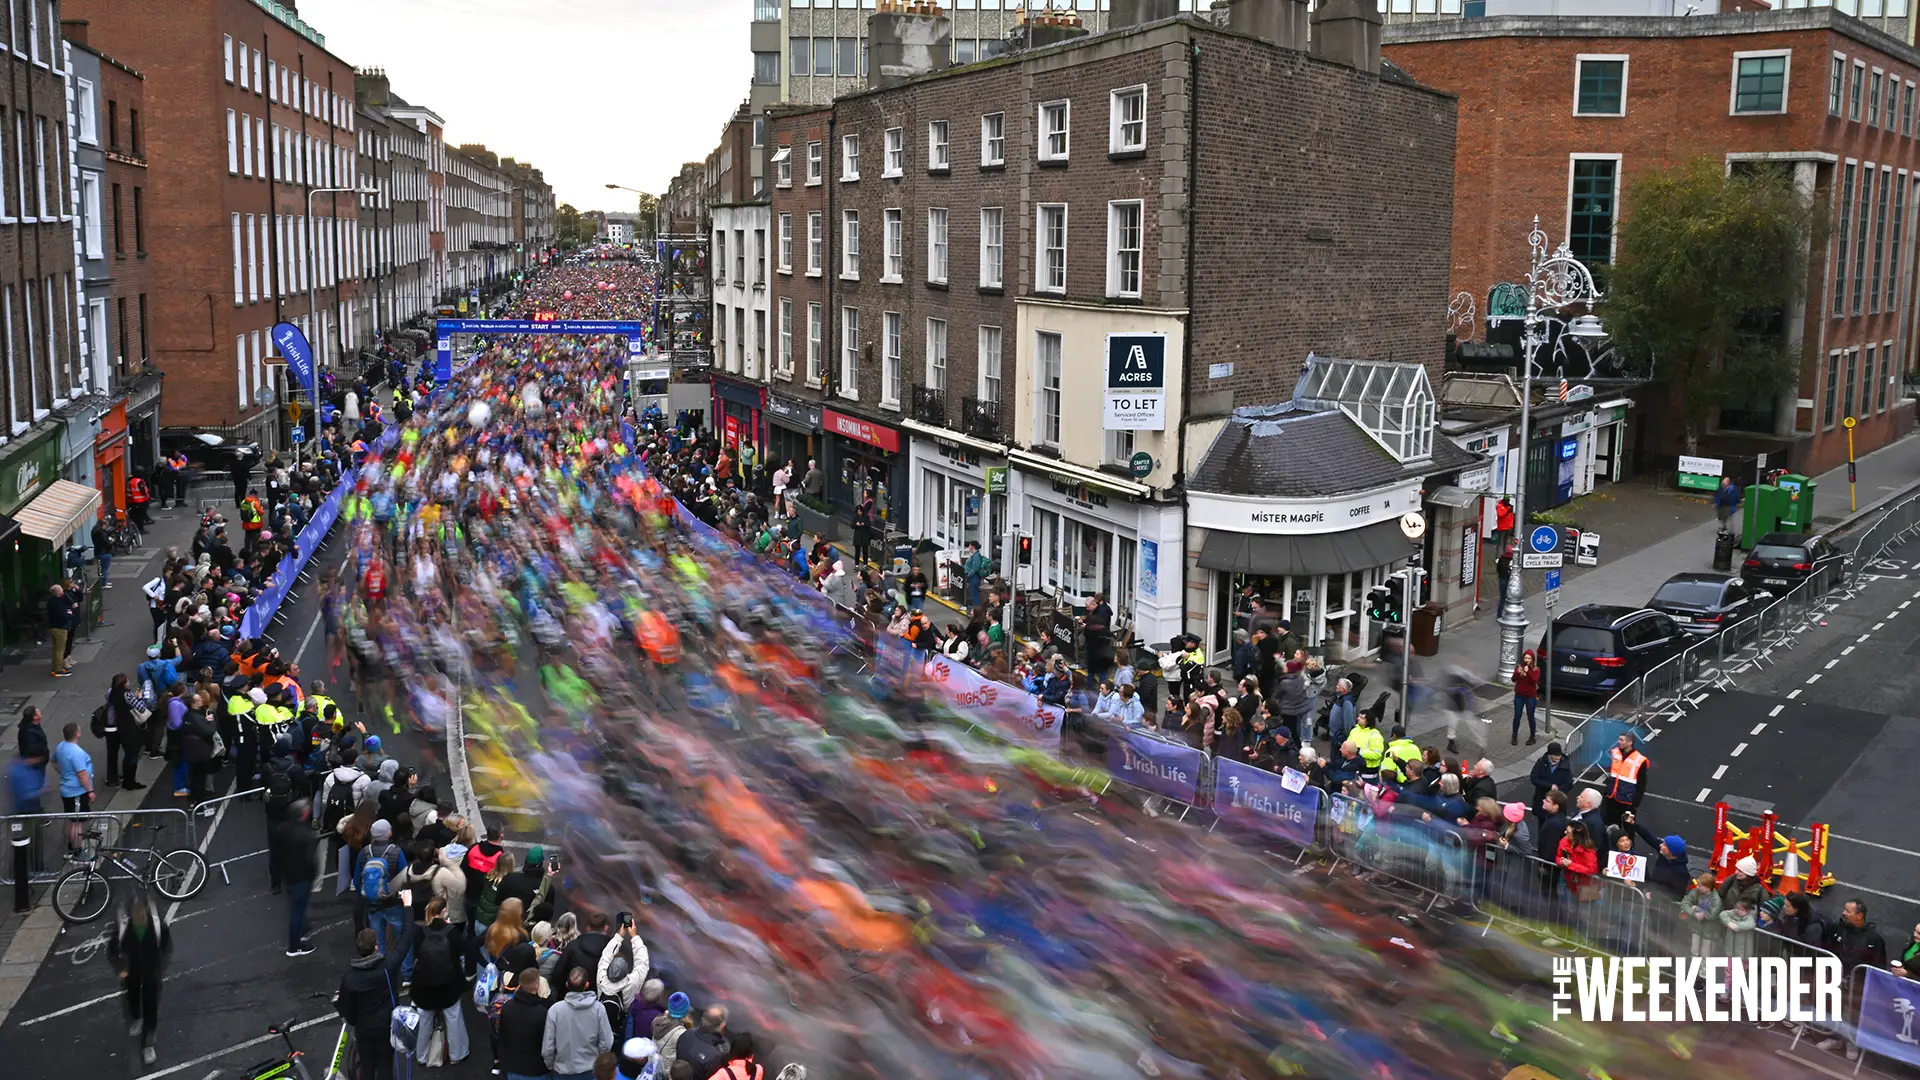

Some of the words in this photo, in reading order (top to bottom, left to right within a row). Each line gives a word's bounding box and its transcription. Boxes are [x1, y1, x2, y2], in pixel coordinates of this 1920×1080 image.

[285, 341, 300, 361] Irish
[296, 358, 310, 376] Life
[1118, 372, 1153, 382] ACRES
[1112, 399, 1131, 410] TO
[1135, 399, 1158, 410] LET
[836, 416, 862, 438] INSOMNIA
[1349, 505, 1371, 517] COFFEE
[1383, 500, 1391, 509] 1A
[1132, 753, 1159, 777] Irish
[1161, 765, 1188, 784] Life
[1244, 790, 1273, 813] Irish
[1276, 801, 1302, 824] Life
